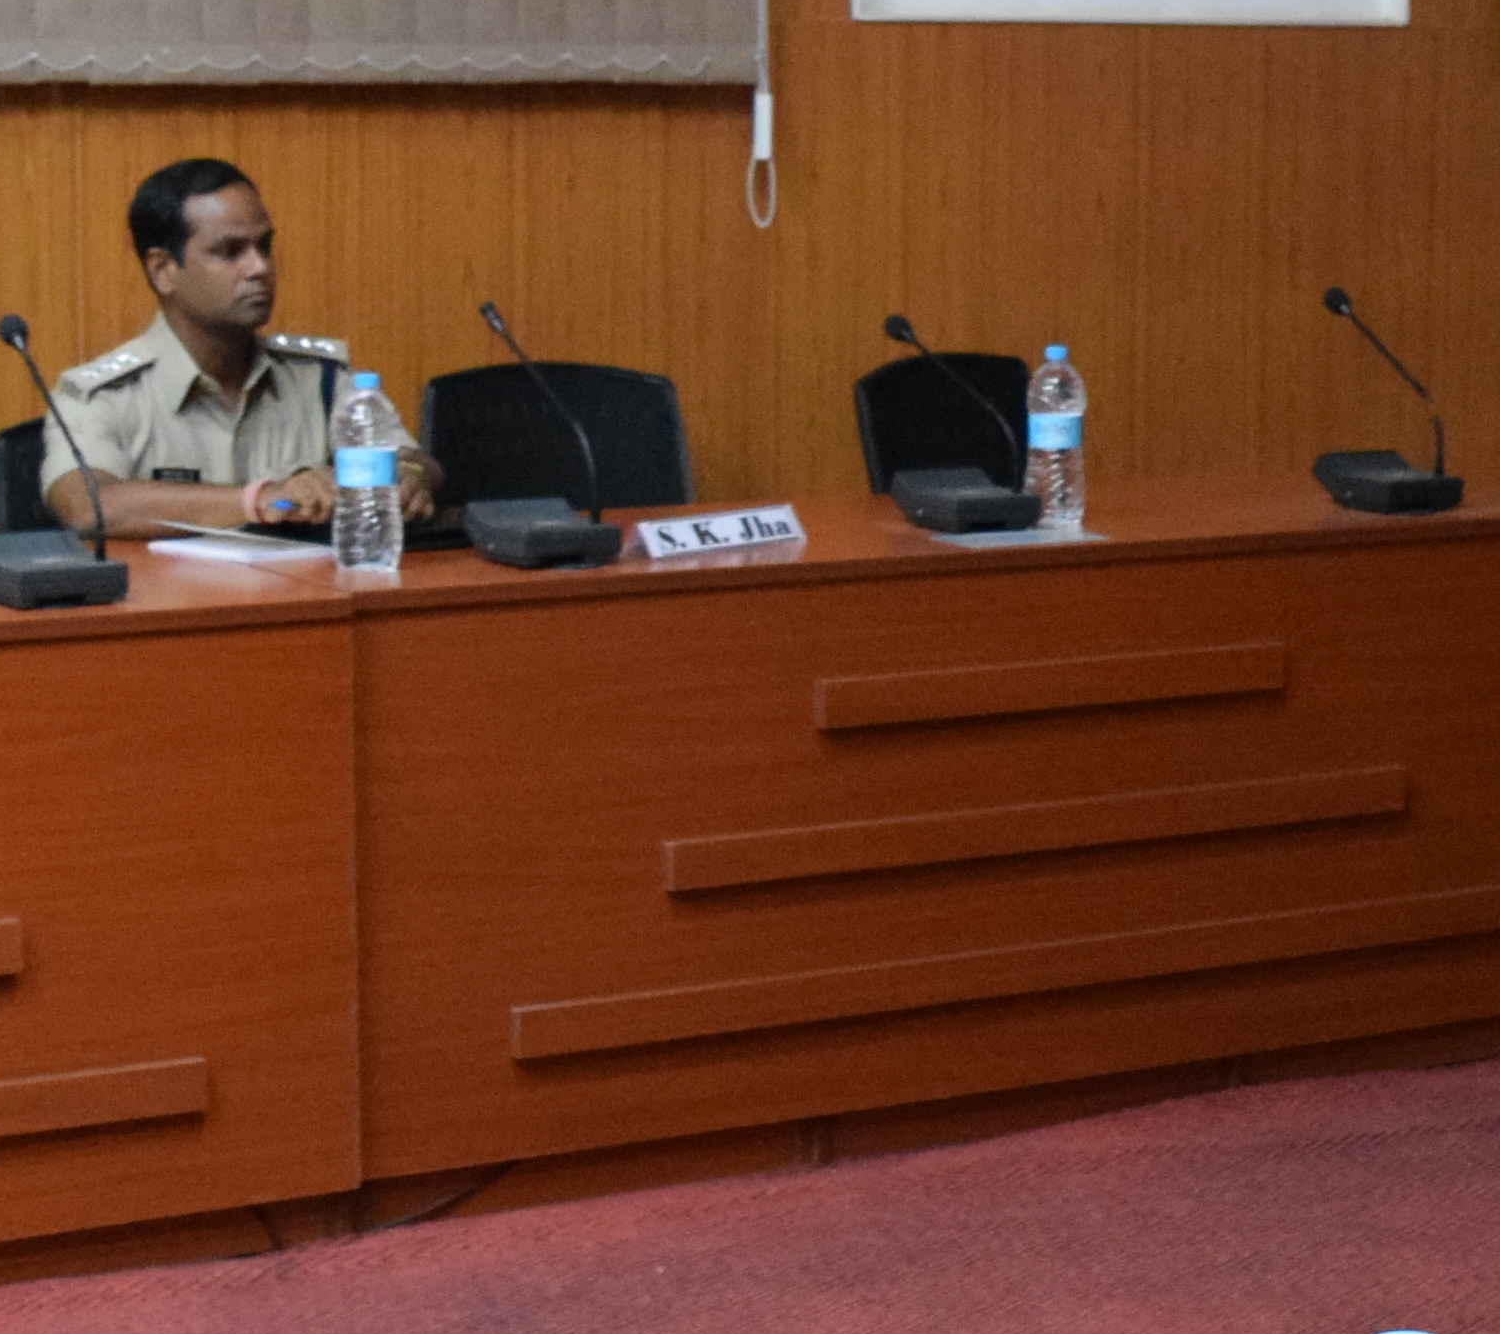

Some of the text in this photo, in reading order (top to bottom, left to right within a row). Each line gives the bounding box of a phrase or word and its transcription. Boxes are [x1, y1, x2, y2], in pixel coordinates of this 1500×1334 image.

[656, 514, 792, 549] S. K. Jha
